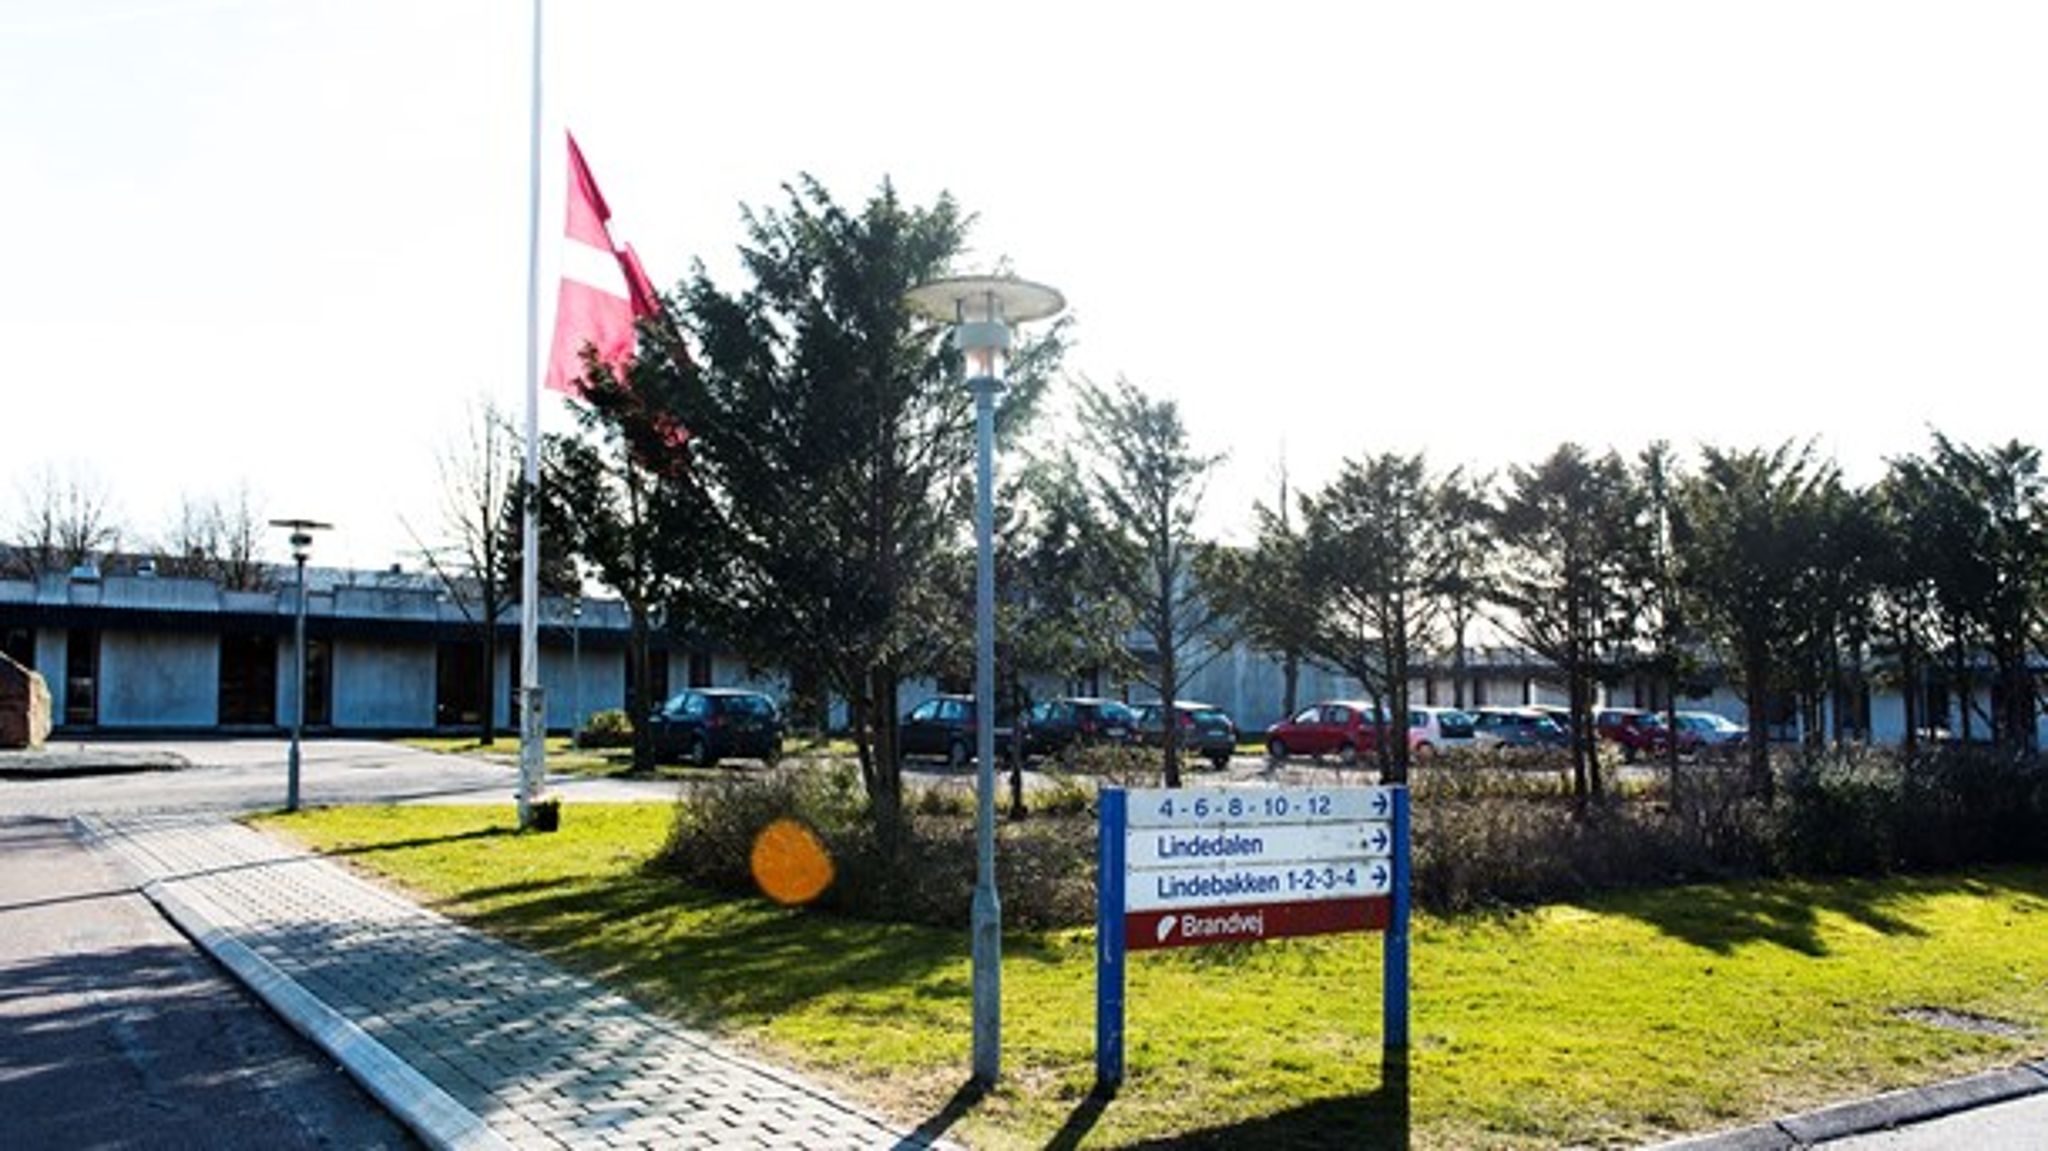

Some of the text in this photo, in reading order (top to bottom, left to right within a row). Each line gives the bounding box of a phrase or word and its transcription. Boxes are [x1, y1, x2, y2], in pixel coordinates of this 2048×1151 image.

[1158, 799, 1173, 817] 4
[1194, 798, 1208, 816] 6
[1228, 798, 1242, 816] 8
[1264, 796, 1288, 816] 10
[1308, 795, 1331, 815] 12
[1157, 835, 1263, 857] Lindedalen
[1157, 868, 1356, 897] Lindebakken 1-2-3-4
[1181, 909, 1264, 937] Brandvej
